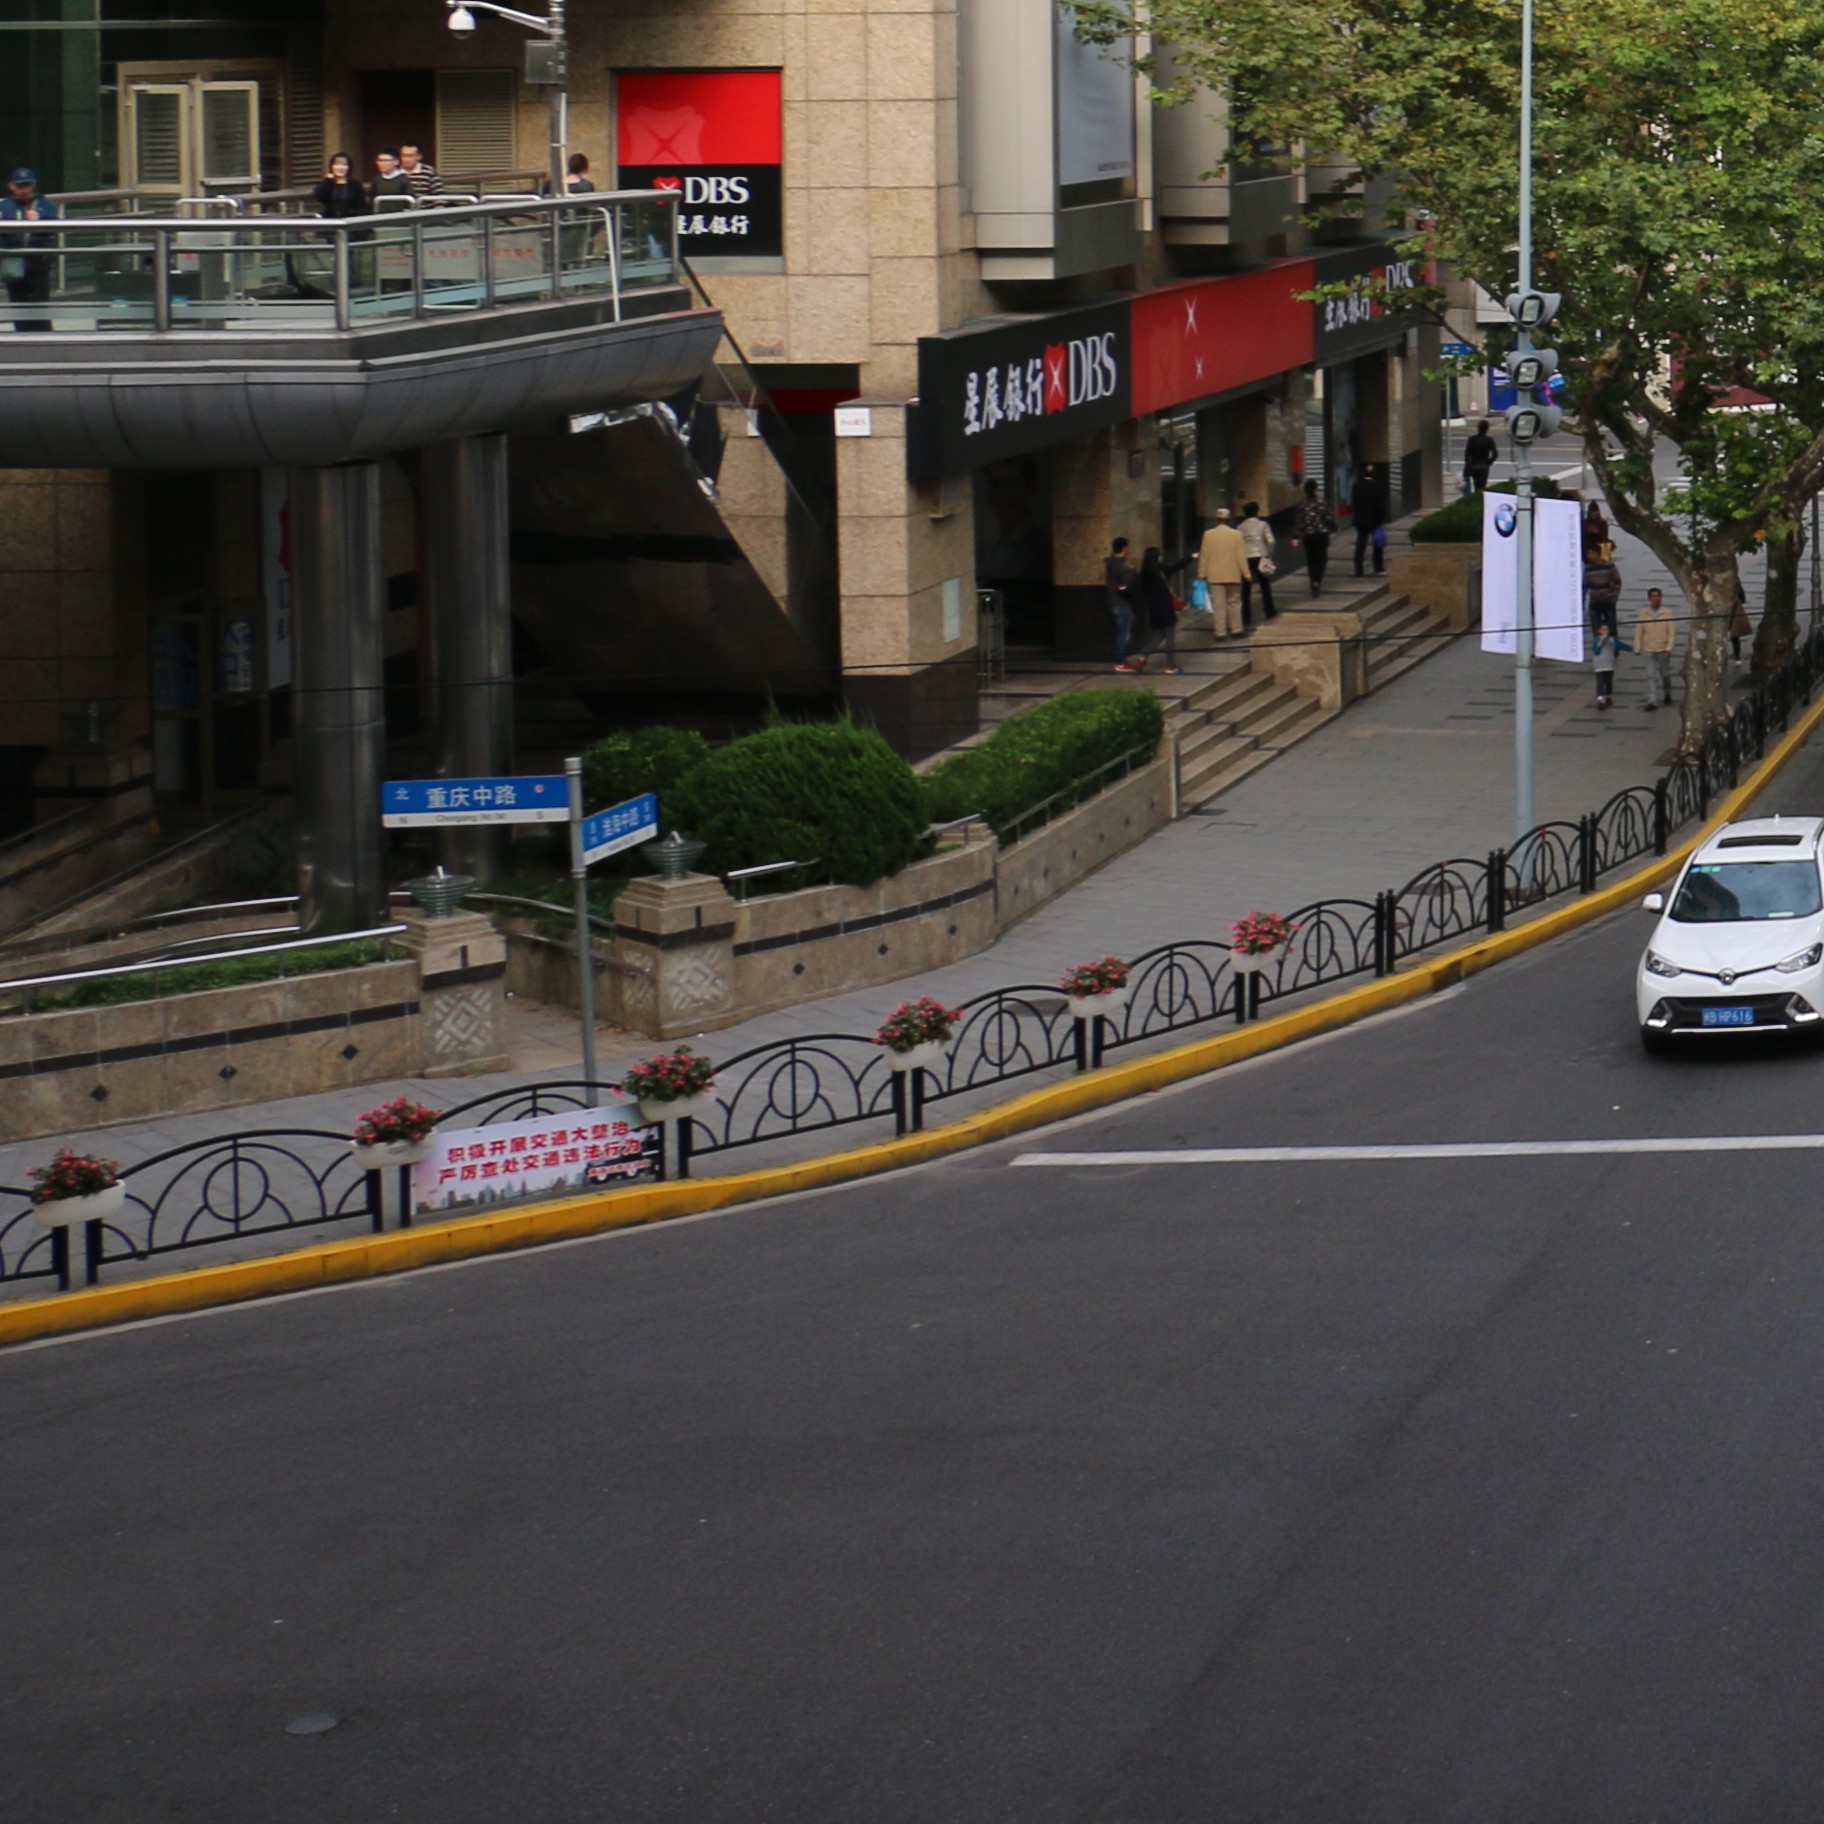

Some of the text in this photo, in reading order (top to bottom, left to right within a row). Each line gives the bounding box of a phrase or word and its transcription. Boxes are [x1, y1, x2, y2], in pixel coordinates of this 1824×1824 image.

[684, 176, 750, 204] DBS
[1068, 332, 1117, 406] DBS
[395, 787, 409, 800] 北
[426, 785, 517, 809] 重庆中路
[447, 1120, 629, 1162] 积极开展交通大整治
[438, 1139, 642, 1185] 严厉查处交通违法行为
